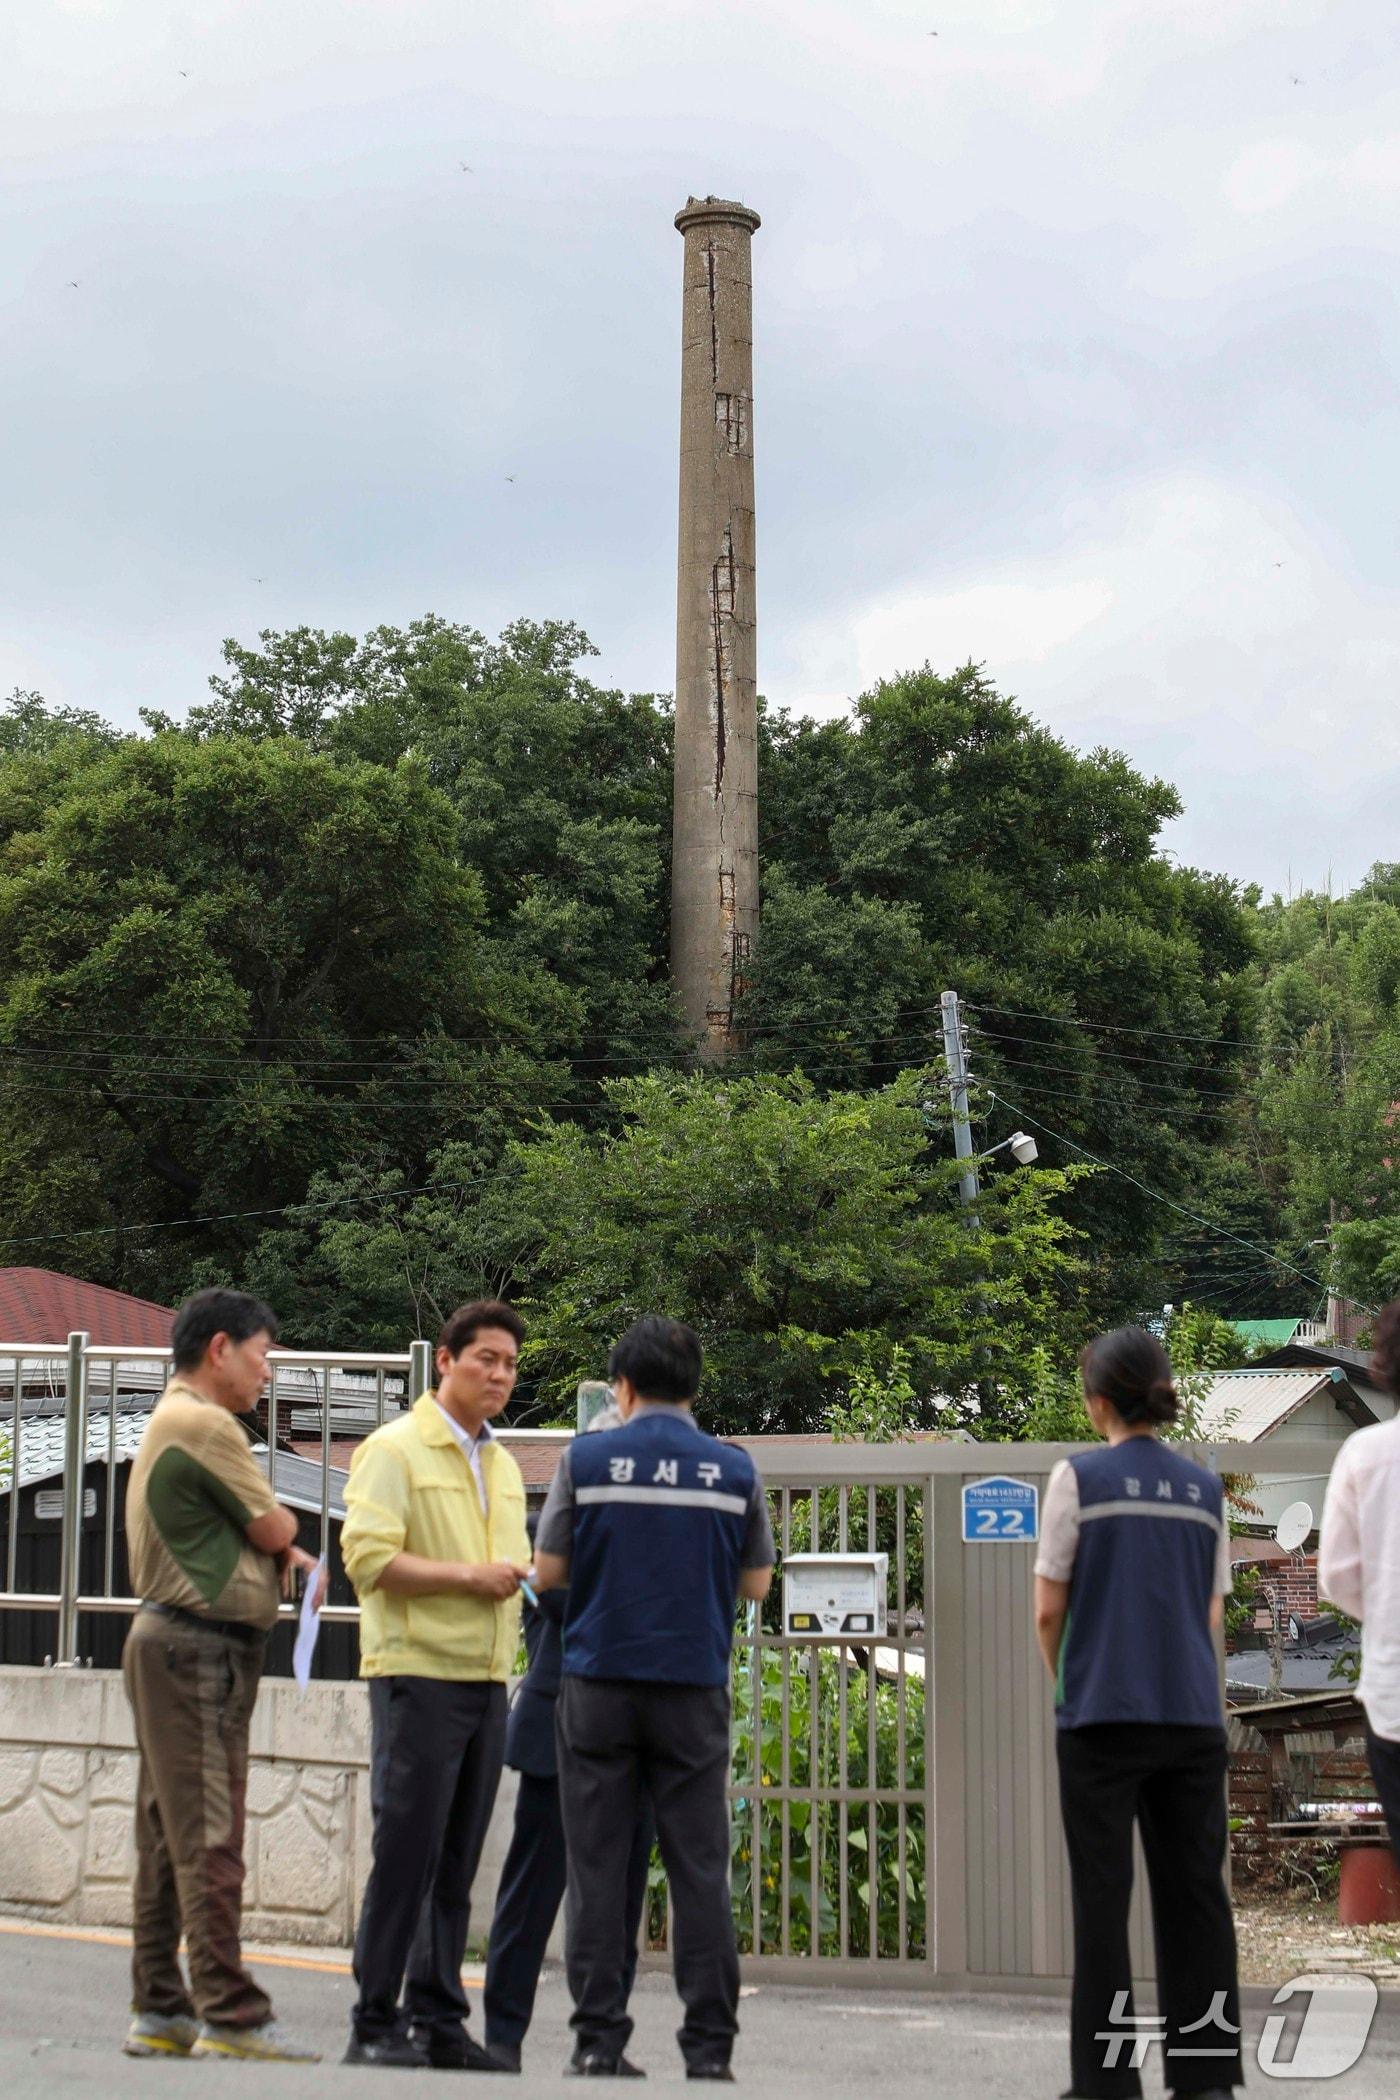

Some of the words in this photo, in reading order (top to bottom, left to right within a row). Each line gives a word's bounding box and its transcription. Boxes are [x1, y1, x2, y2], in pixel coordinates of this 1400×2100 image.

[609, 1457, 722, 1487] 강서구
[1123, 1477, 1202, 1504] 강서구
[976, 1509, 1025, 1535] 22
